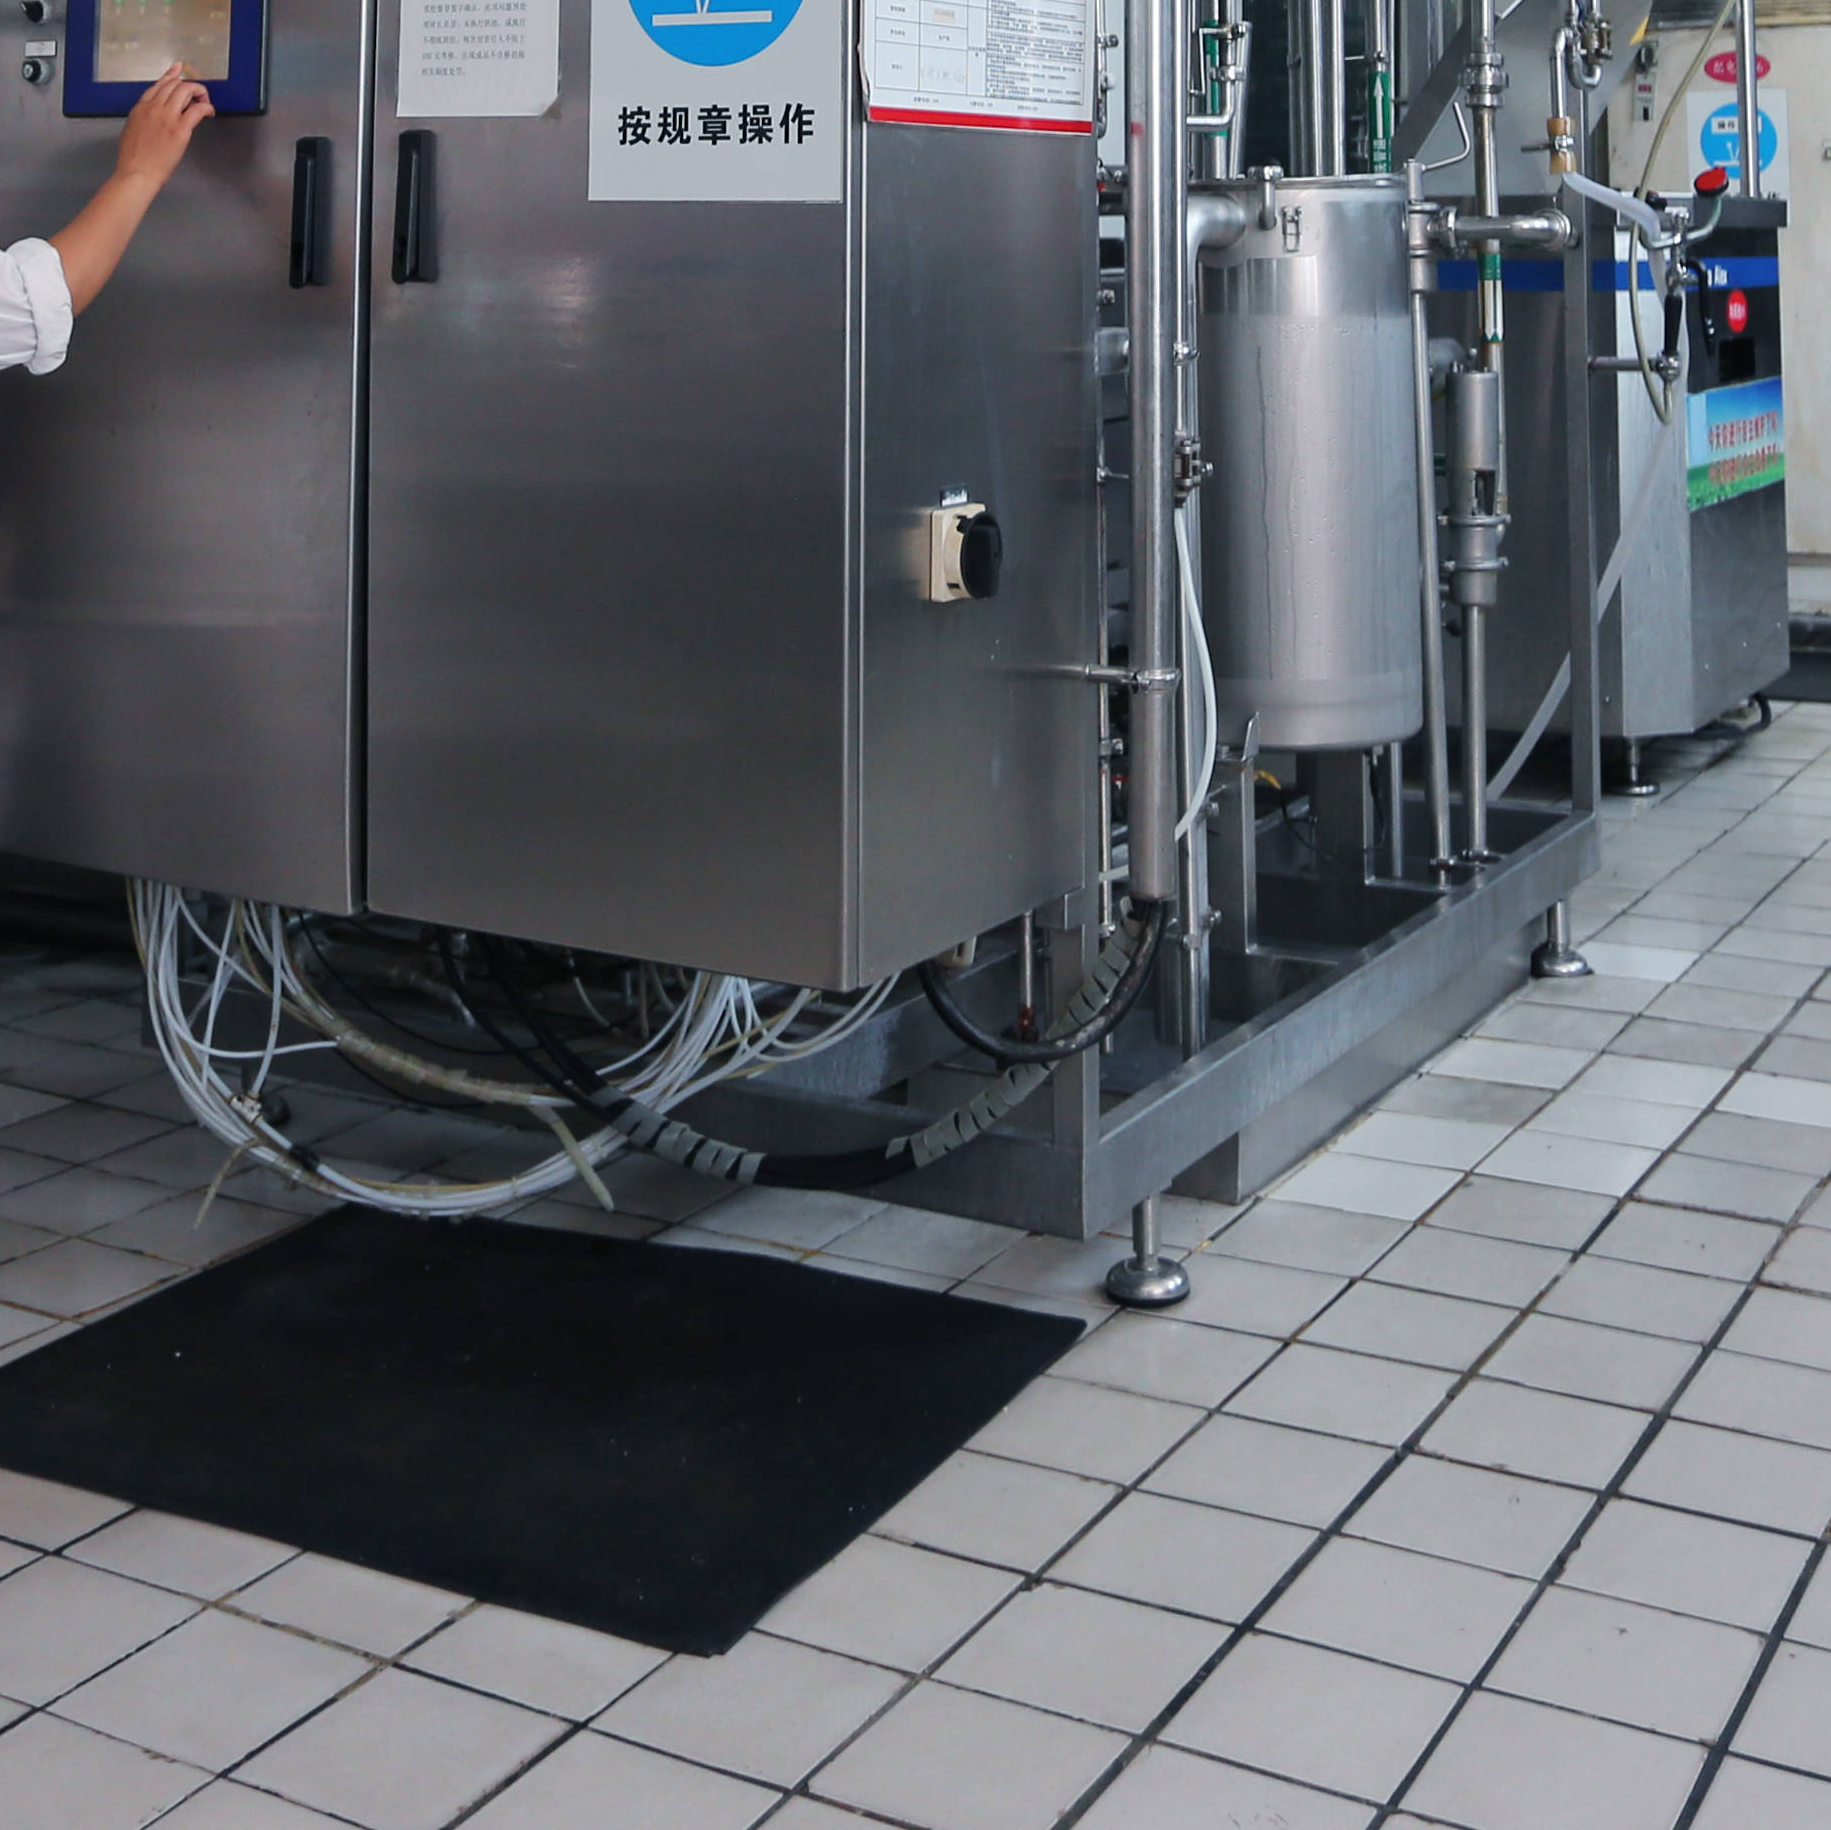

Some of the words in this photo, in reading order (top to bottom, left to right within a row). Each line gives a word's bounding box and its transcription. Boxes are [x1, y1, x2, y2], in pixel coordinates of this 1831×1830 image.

[618, 102, 816, 147] 按规章操作
